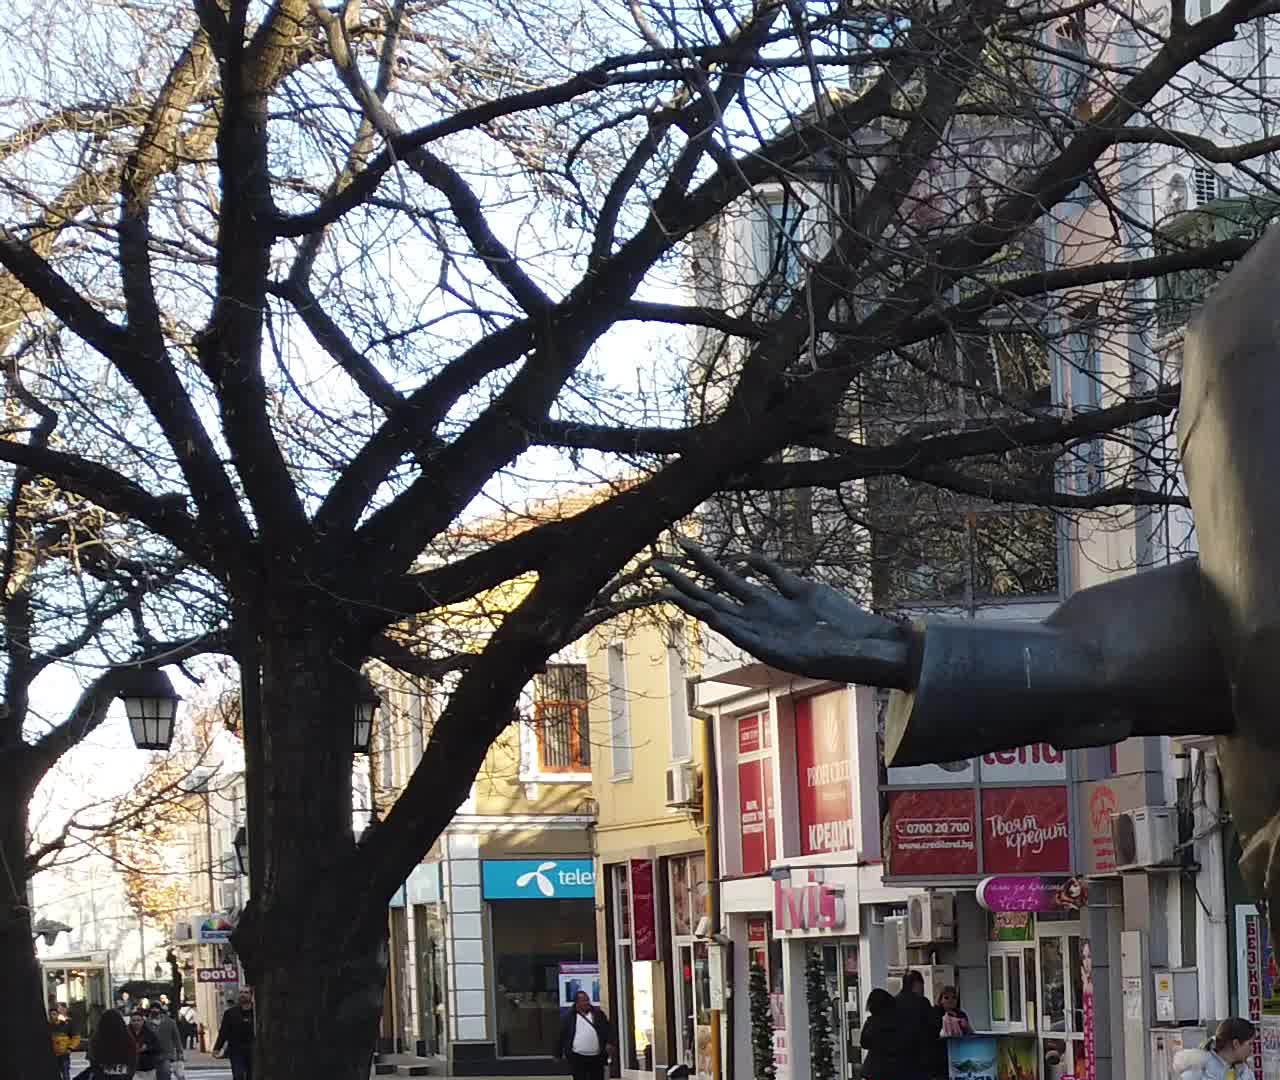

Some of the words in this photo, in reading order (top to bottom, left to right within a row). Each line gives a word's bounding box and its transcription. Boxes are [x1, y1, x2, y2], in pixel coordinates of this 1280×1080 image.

[808, 819, 855, 850] КРЕДИТ
[906, 824, 932, 834] 0700
[935, 823, 948, 833] 20
[950, 822, 970, 832] 700
[986, 815, 1037, 838] Твоят
[1006, 822, 1070, 858] кредит
